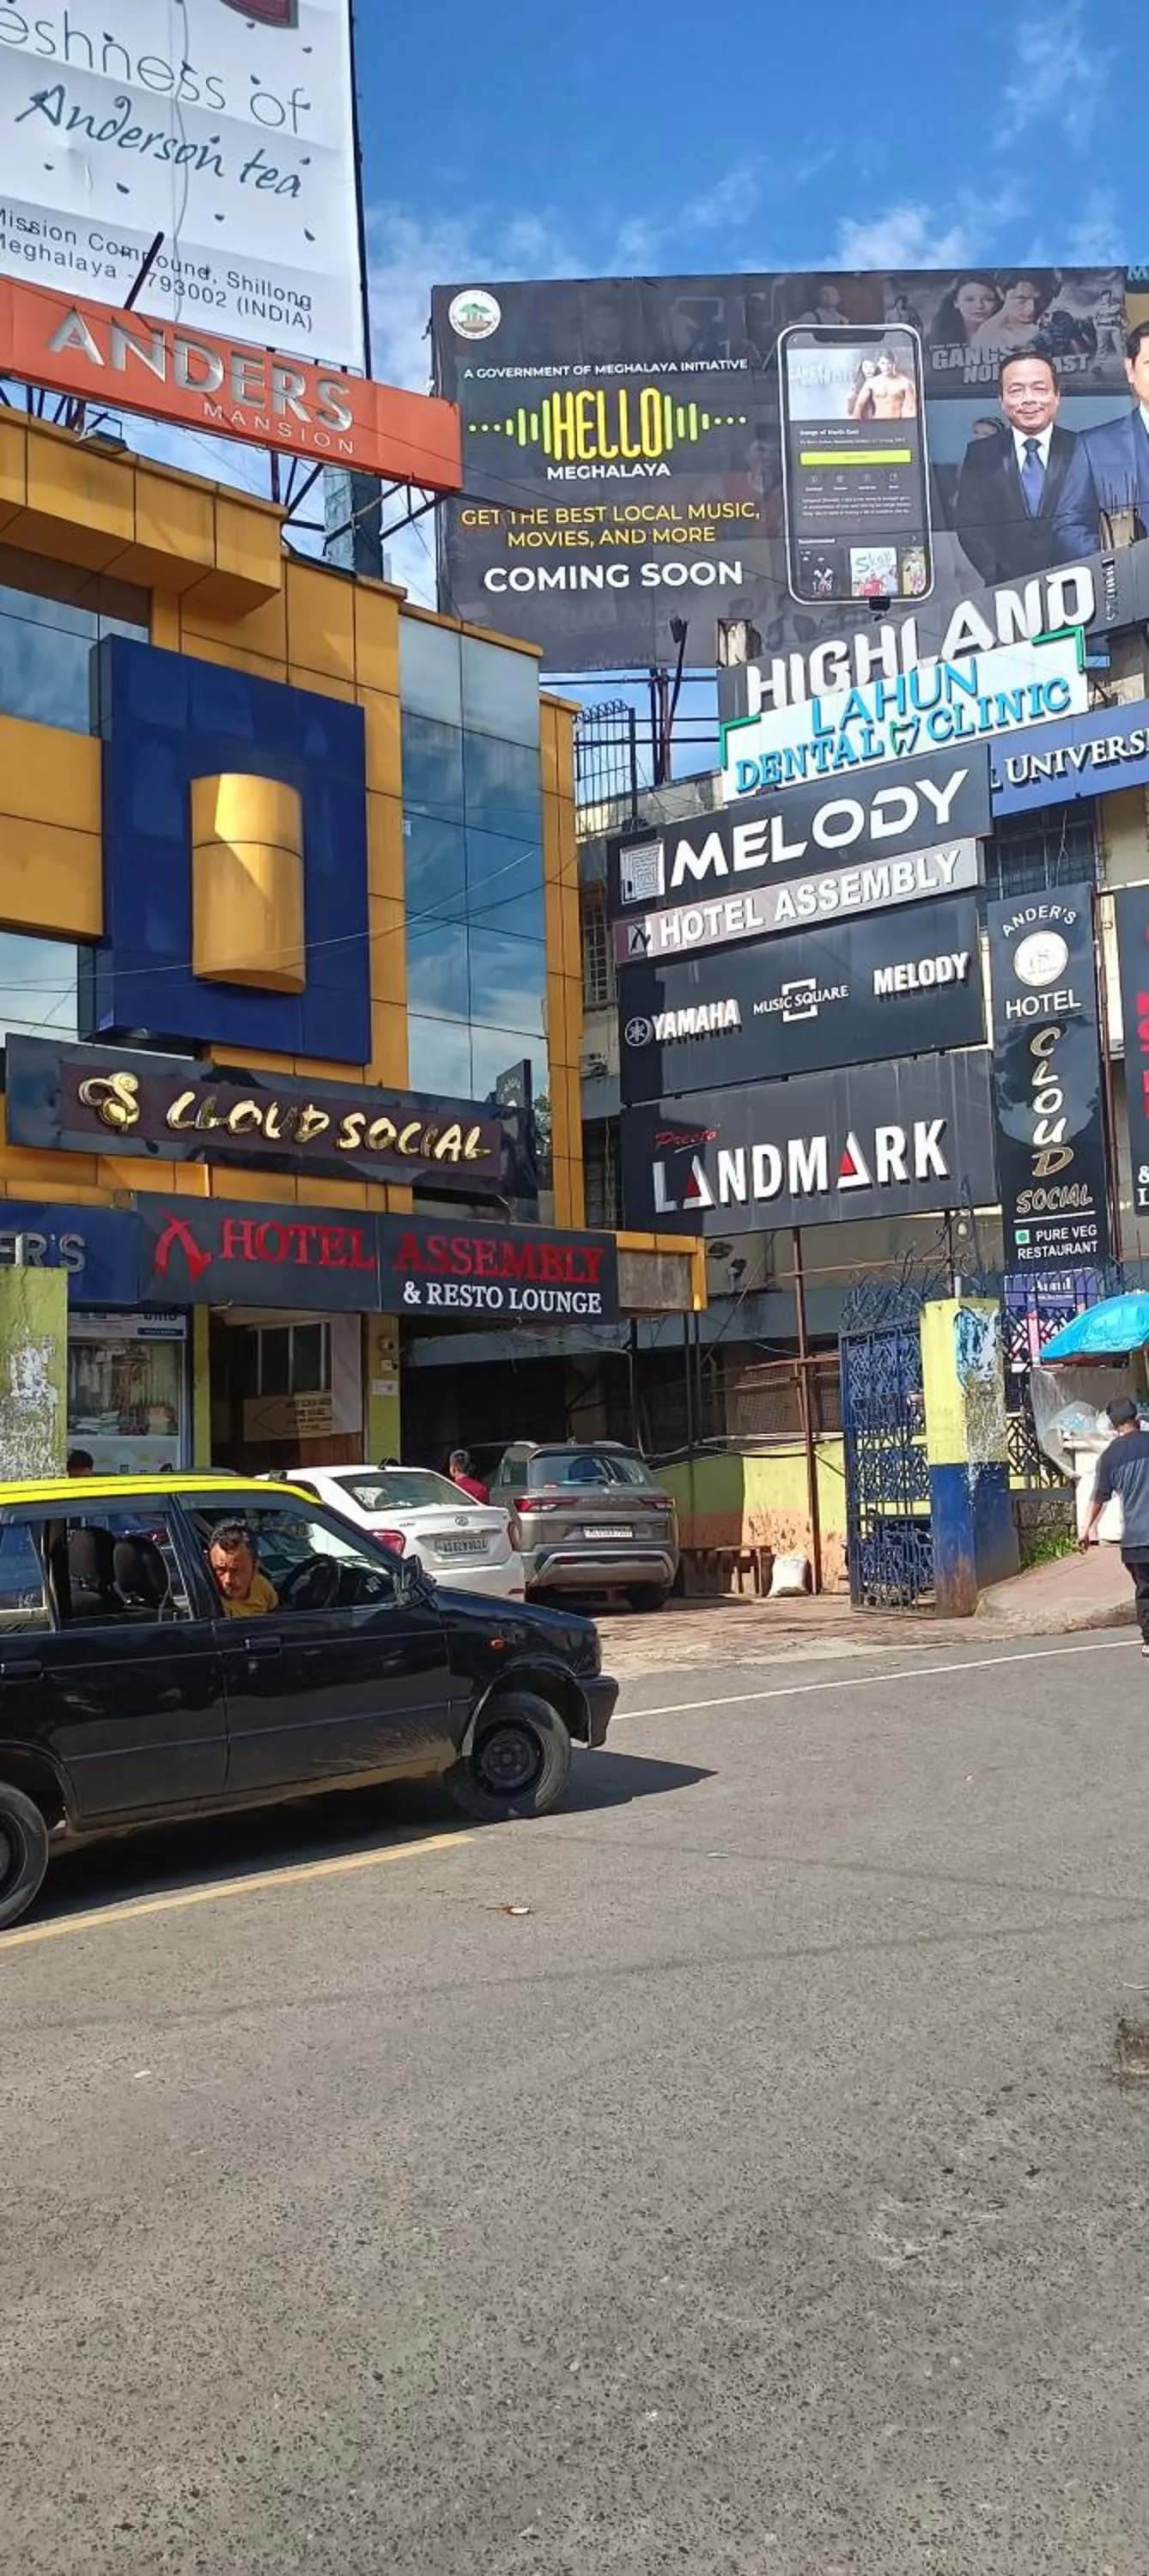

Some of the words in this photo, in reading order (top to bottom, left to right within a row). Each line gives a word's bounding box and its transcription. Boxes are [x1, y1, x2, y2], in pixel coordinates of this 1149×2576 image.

[251, 88, 307, 133] of
[15, 84, 223, 177] Anderson
[240, 149, 301, 198] tea
[148, 272, 228, 307] 793002
[237, 296, 313, 333] (INDIA)
[227, 270, 312, 312] Shillong
[49, 307, 353, 431] ANDERS
[465, 368, 473, 379] A
[476, 365, 569, 378] GOVERNMENT
[574, 364, 592, 375] OF
[595, 361, 678, 374] MEGHALAYA
[681, 358, 748, 372] INITIATIVE
[204, 403, 354, 453] MANSION
[552, 387, 663, 461] HELLO
[547, 463, 671, 480] MEGHALAYA
[462, 509, 499, 525] GET
[508, 508, 548, 525] THE
[555, 507, 606, 524] BEST
[613, 504, 684, 521] LOCAL
[688, 502, 760, 519] MUSIC,
[508, 532, 594, 549] MOVIES,
[599, 528, 646, 545] AND
[653, 526, 716, 544] MORE
[483, 563, 629, 592] COMING
[641, 560, 744, 587] SOON
[745, 565, 1097, 717] HIGHLAND
[810, 656, 978, 738] LAHUN
[735, 727, 885, 793] DENTAL
[925, 677, 1072, 743] CLINIC
[670, 769, 970, 888] MELODY
[660, 897, 764, 948] HOTEL
[774, 848, 961, 923] ASSEMBLY
[1002, 904, 1076, 938] ANDER'S
[873, 951, 970, 996] MELODY
[651, 999, 741, 1042] YAMAHA
[752, 995, 793, 1016] MUSIC
[793, 985, 849, 1007] SQUARE
[1006, 989, 1081, 1019] HOTEL
[336, 1112, 491, 1163] SOCIAL
[652, 1118, 950, 1213] LANDMARK
[1016, 1182, 1093, 1214] SOCIAL
[220, 1218, 376, 1270] HOTEL
[393, 1231, 605, 1284] ASSEMBLY
[1018, 1241, 1098, 1261] RESTAURANT
[1036, 1228, 1069, 1242] PURE
[1071, 1224, 1097, 1239] VEG
[402, 1280, 422, 1305] &
[425, 1283, 504, 1309] RESTO
[508, 1288, 603, 1315] LOUNGE
